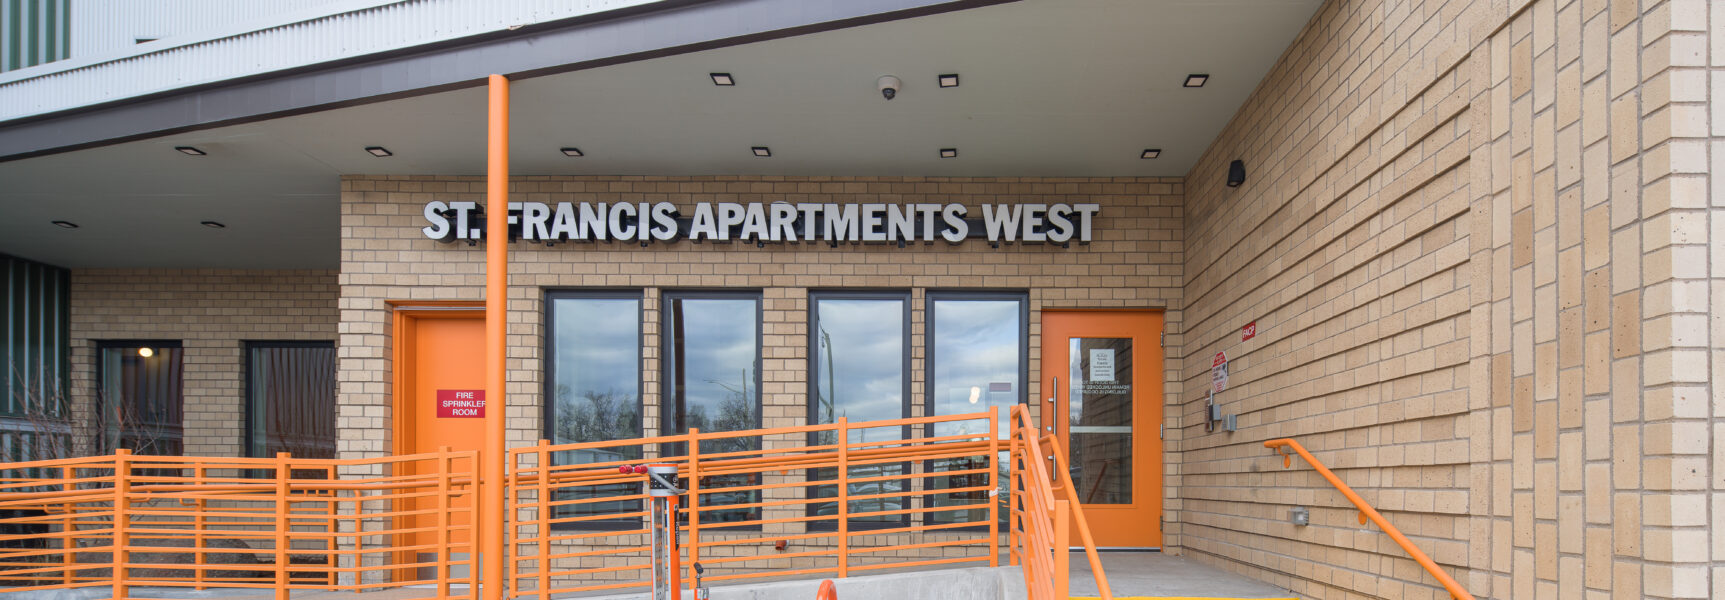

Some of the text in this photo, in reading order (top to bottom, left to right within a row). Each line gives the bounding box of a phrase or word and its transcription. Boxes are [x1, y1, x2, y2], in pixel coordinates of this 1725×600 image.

[422, 200, 1100, 243] ST. FRANCIS APARTMENTS WEST
[455, 391, 474, 399] FIRE
[452, 408, 478, 416] ROOM
